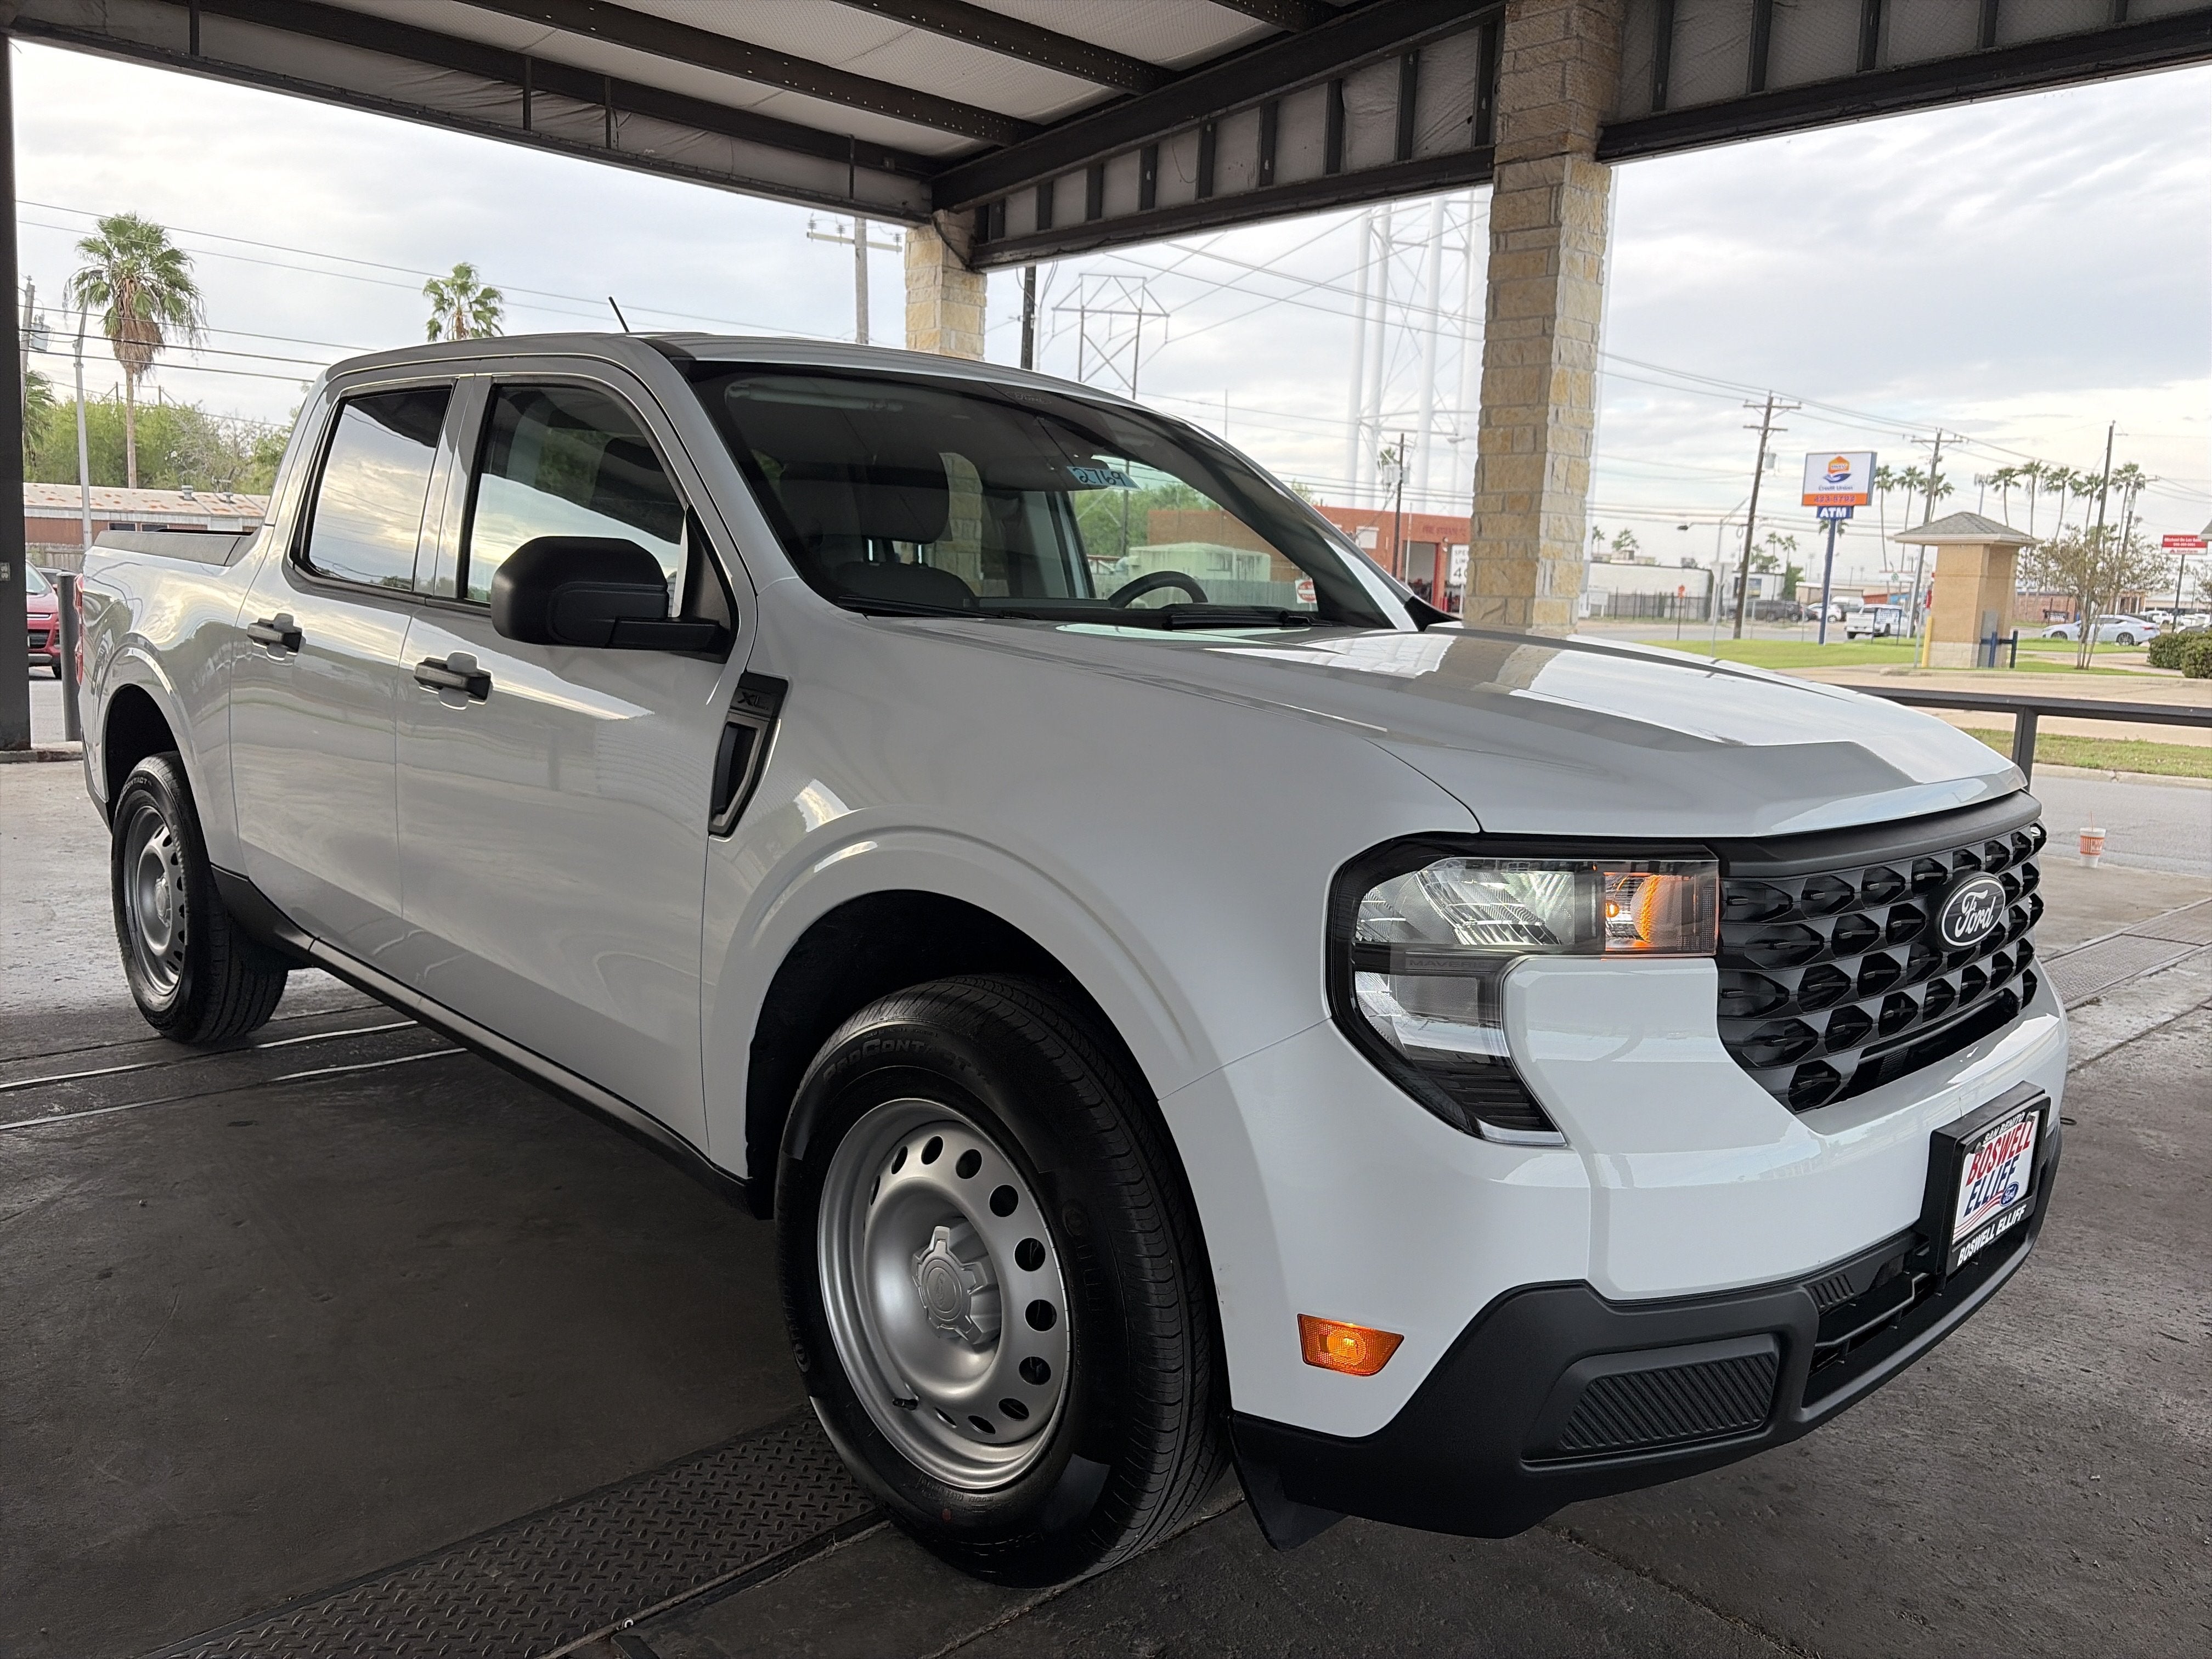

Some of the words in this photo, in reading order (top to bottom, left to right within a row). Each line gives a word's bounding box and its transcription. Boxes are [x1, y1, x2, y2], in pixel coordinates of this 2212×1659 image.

[1072, 467, 1127, 487] 2769
[1820, 507, 1847, 518] ATM
[737, 691, 768, 710] XL
[1954, 889, 1997, 938] Ford
[1409, 960, 1500, 969] MAVERIC
[1983, 1126, 2000, 1145] SAN
[1998, 1111, 2026, 1135] BENITO
[1965, 1121, 2035, 1187] BOSWELL
[1963, 1154, 2020, 1218] ELLIFF
[1957, 1223, 1996, 1267] BOSWELL
[1995, 1204, 2027, 1236] ELLIFF
